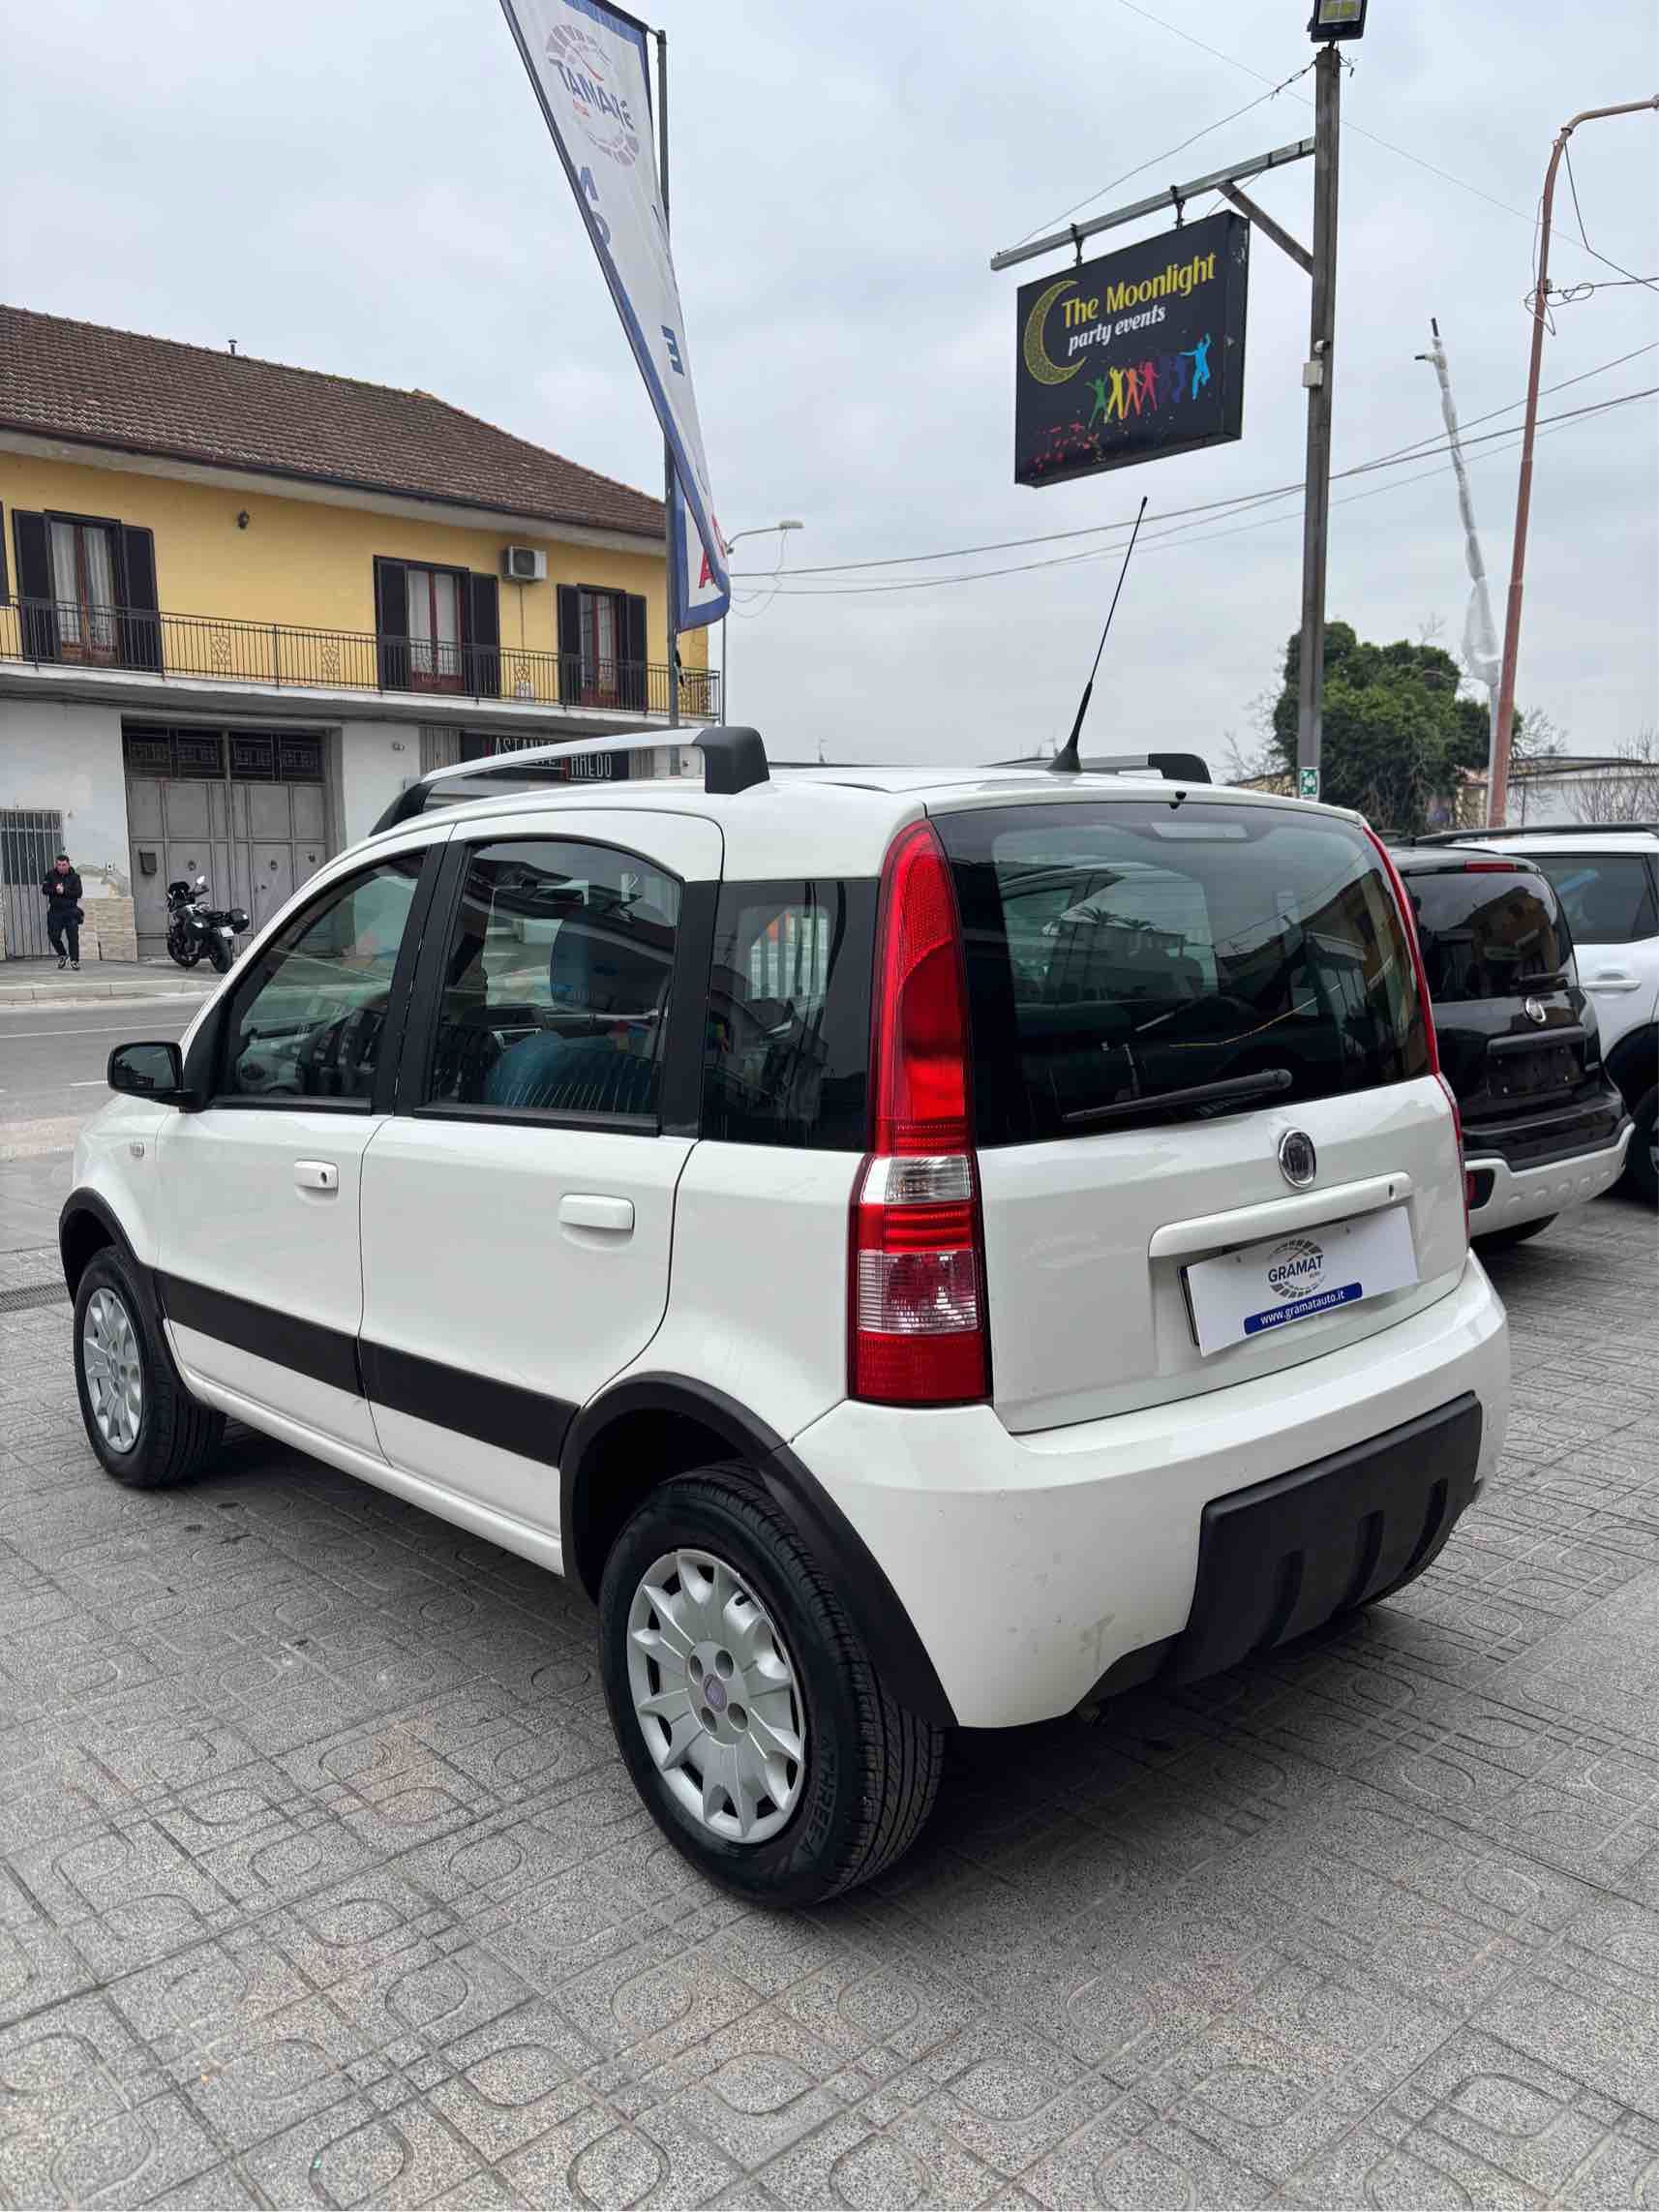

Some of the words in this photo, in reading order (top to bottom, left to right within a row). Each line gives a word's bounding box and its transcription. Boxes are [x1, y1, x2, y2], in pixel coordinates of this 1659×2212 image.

[1062, 296, 1100, 328] The
[1106, 252, 1217, 315] Moonlight
[1068, 322, 1112, 356] party
[1114, 304, 1166, 336] events
[1268, 1254, 1324, 1284] GRAMAT
[1260, 1288, 1345, 1326] www.gramatauto.it
